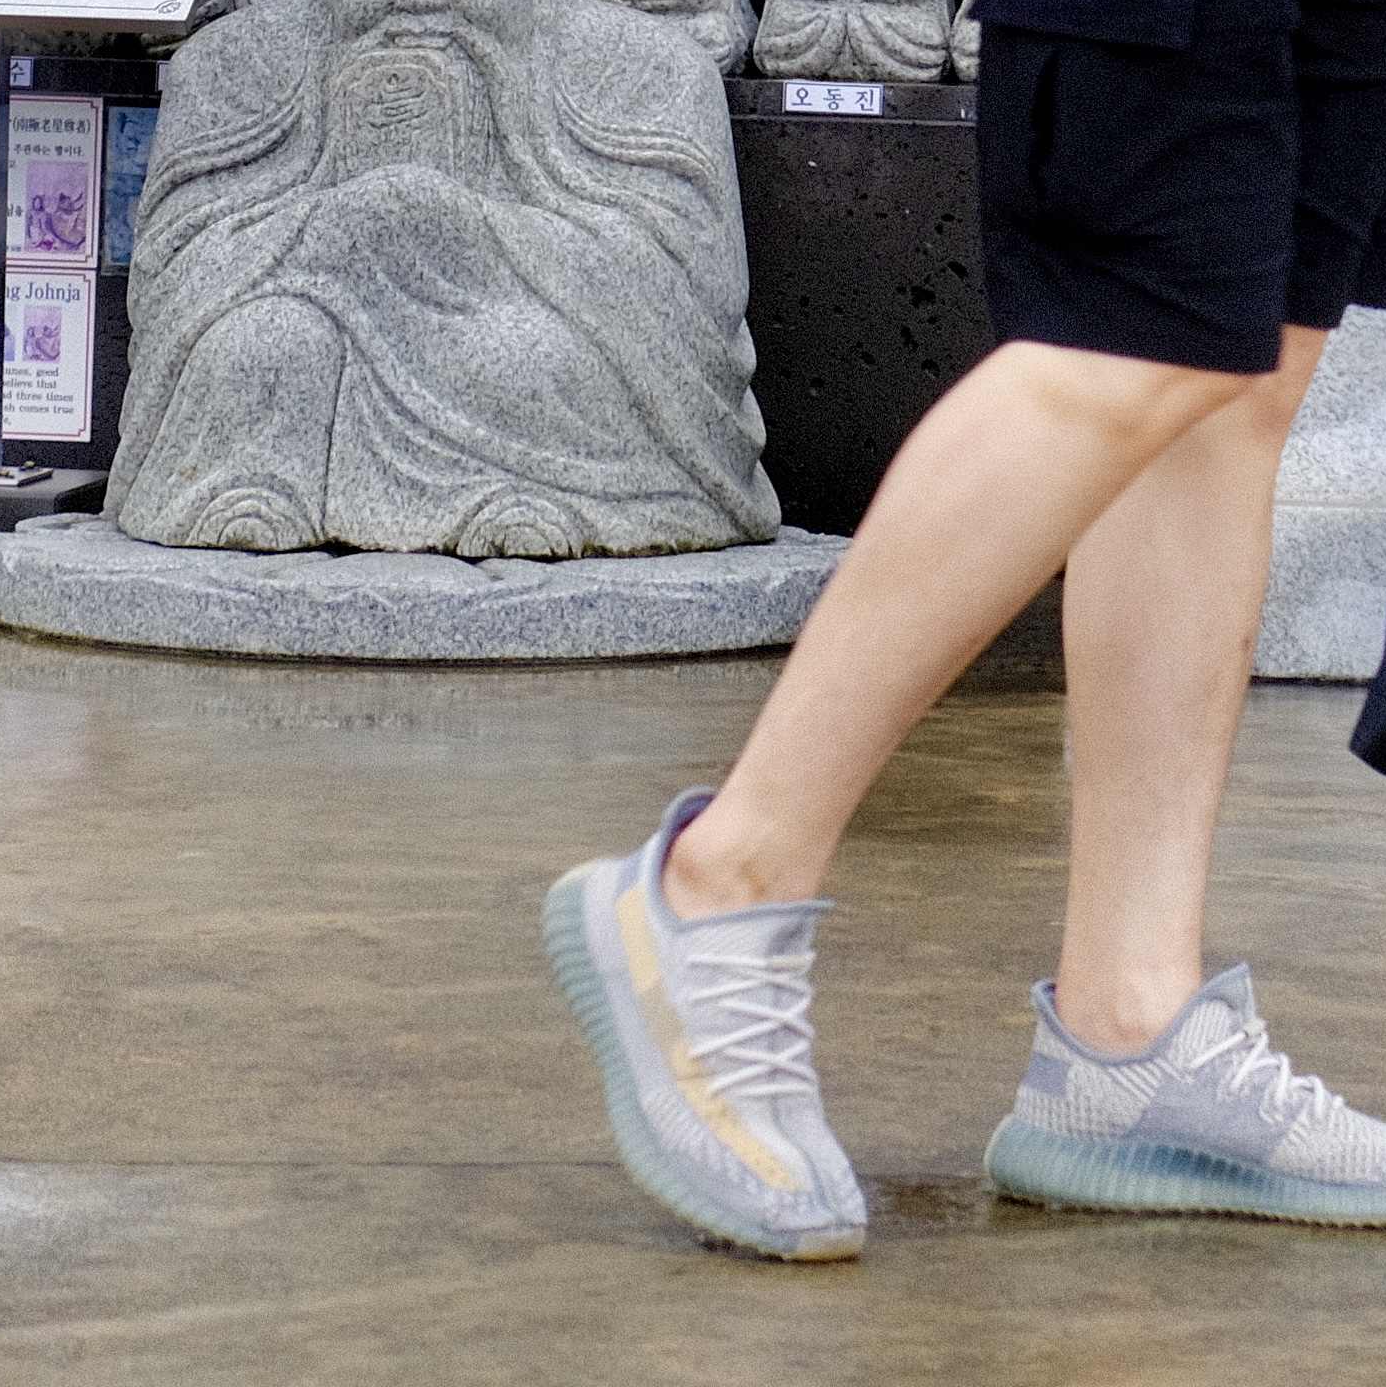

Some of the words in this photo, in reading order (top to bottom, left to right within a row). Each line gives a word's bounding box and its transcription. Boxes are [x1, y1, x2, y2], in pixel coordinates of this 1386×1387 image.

[792, 88, 875, 112] 오동진
[24, 282, 81, 303] Johnja
[36, 369, 59, 377] good
[46, 392, 74, 402] times
[19, 404, 49, 413] comes
[53, 405, 74, 414] true
